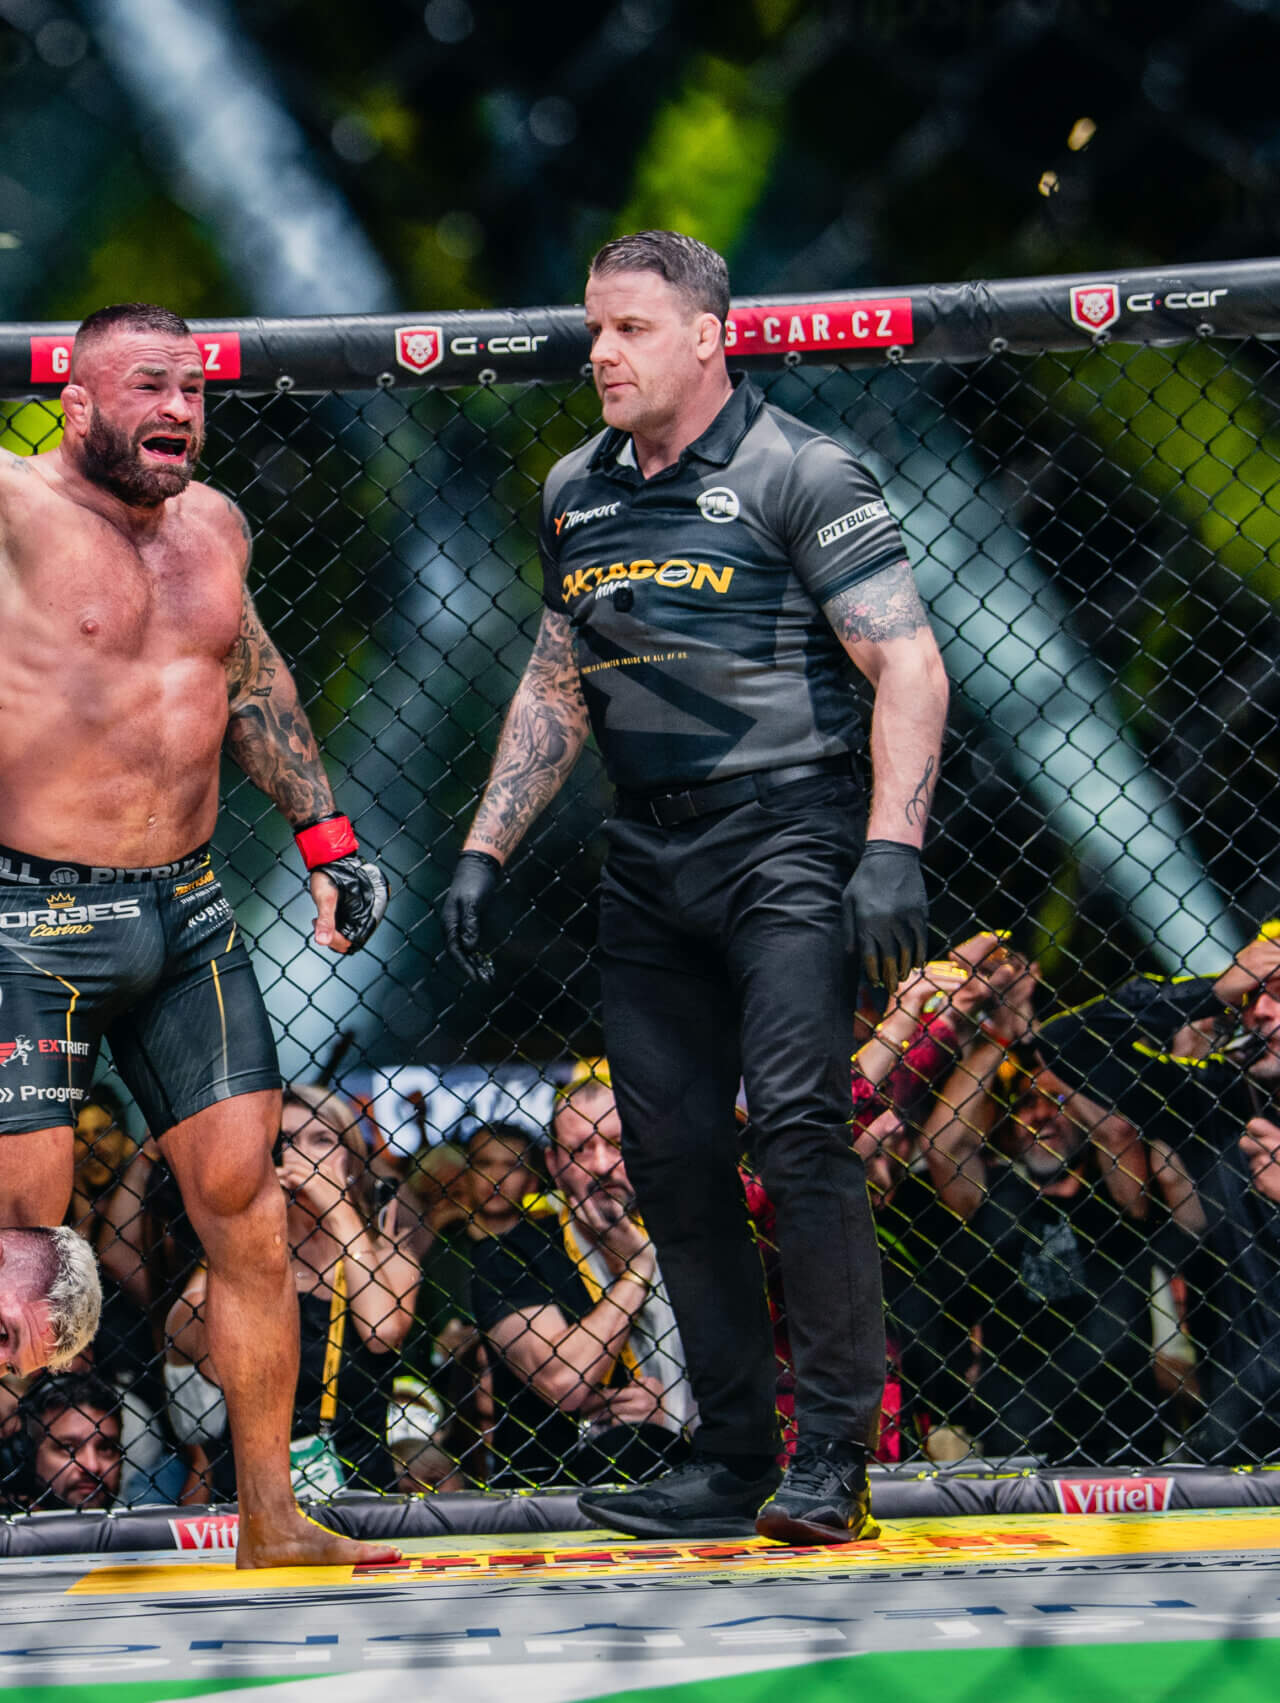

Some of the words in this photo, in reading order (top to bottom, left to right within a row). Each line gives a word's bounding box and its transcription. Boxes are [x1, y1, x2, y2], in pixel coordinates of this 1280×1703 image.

[724, 309, 893, 347] G-CAR.CZ
[821, 505, 877, 543] PITBULL
[38, 1039, 90, 1056] EXTRIFIT
[1070, 1482, 1156, 1513] Vittel
[184, 1521, 239, 1549] Vitt
